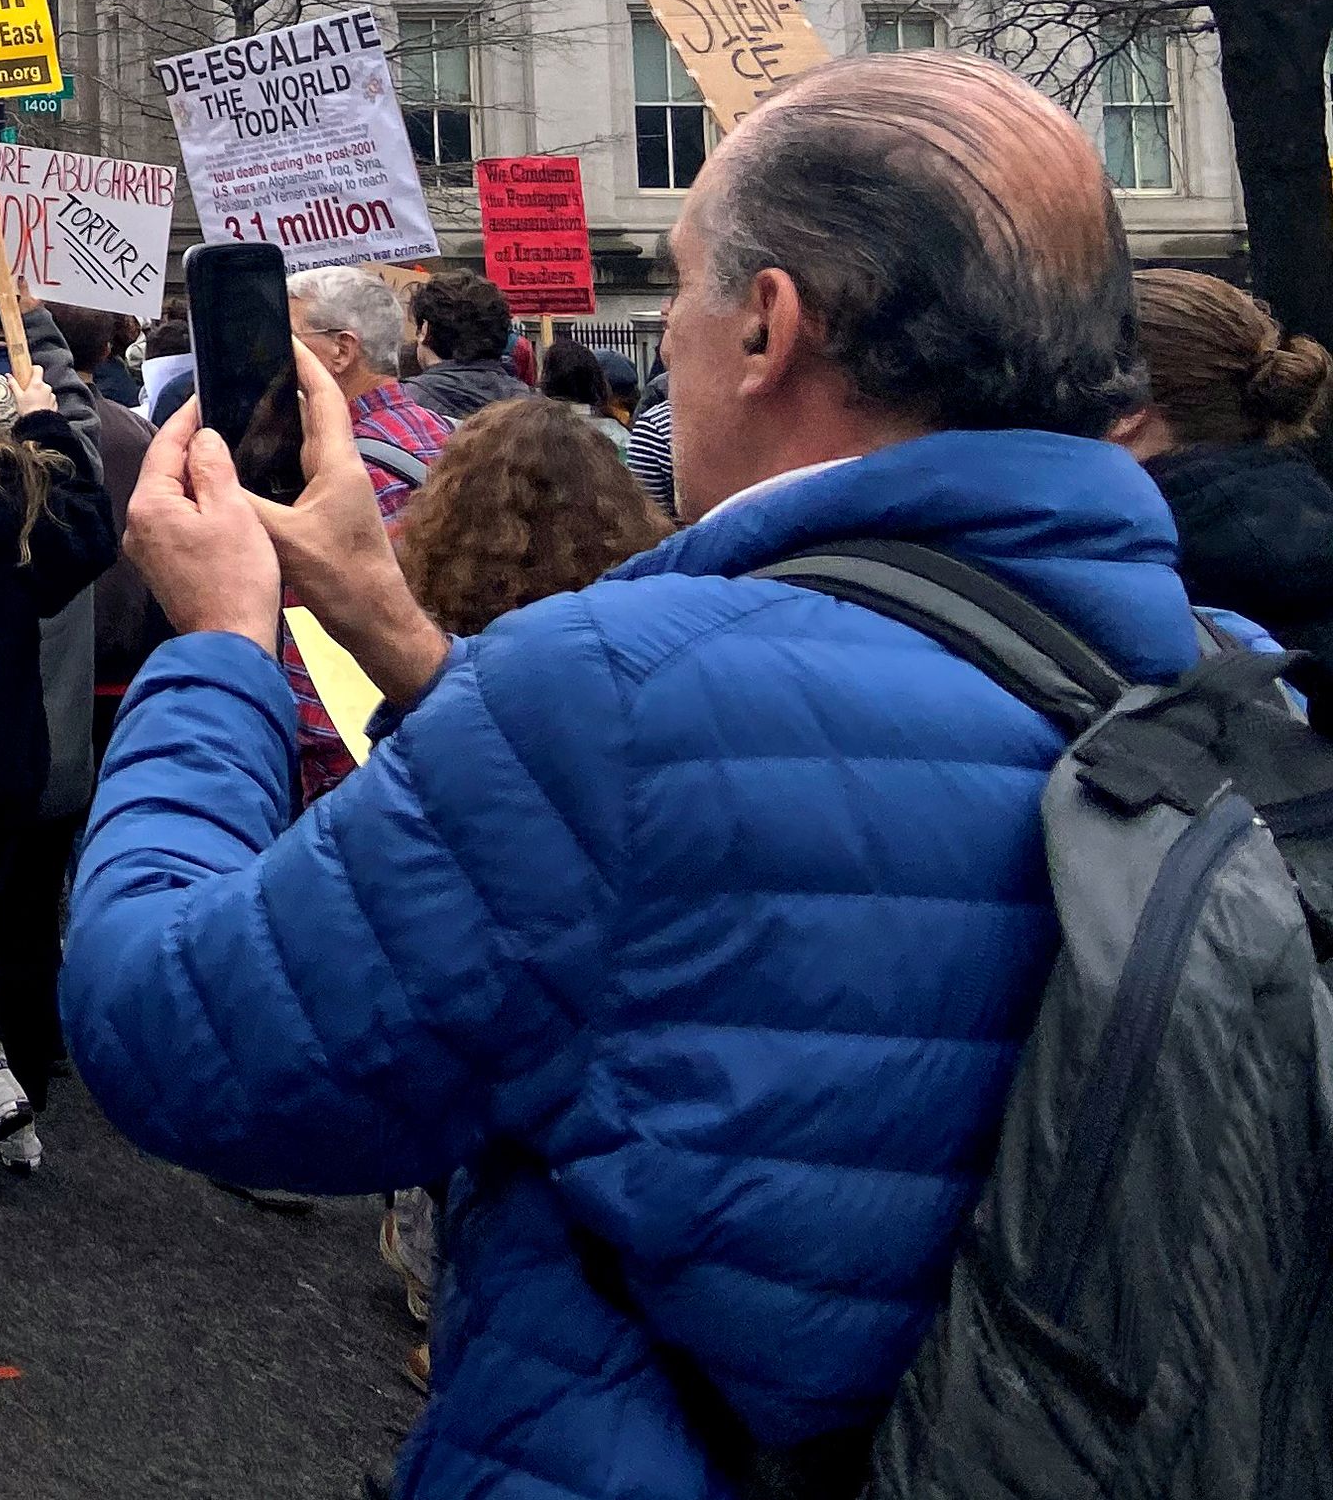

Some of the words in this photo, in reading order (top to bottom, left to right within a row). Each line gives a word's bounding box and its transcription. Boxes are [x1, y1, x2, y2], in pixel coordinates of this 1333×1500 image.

[158, 12, 381, 97] DE-ESCALATE
[732, 44, 790, 84] CE
[24, 100, 57, 112] 1400
[200, 88, 246, 120] THE
[259, 64, 351, 106] WORLD
[230, 98, 320, 139] TODAY!
[237, 163, 269, 179] deaths
[271, 157, 303, 174] during
[304, 151, 322, 165] the
[326, 140, 375, 164] post-2001
[233, 182, 255, 195] wars
[254, 194, 270, 206] and
[271, 188, 307, 204] Yemen
[318, 180, 343, 195] likely
[345, 178, 355, 189] to
[358, 172, 389, 188] reach
[57, 193, 158, 294] TORTURE
[225, 212, 267, 241] 31
[373, 250, 391, 261] war
[395, 243, 435, 258] crimes.
